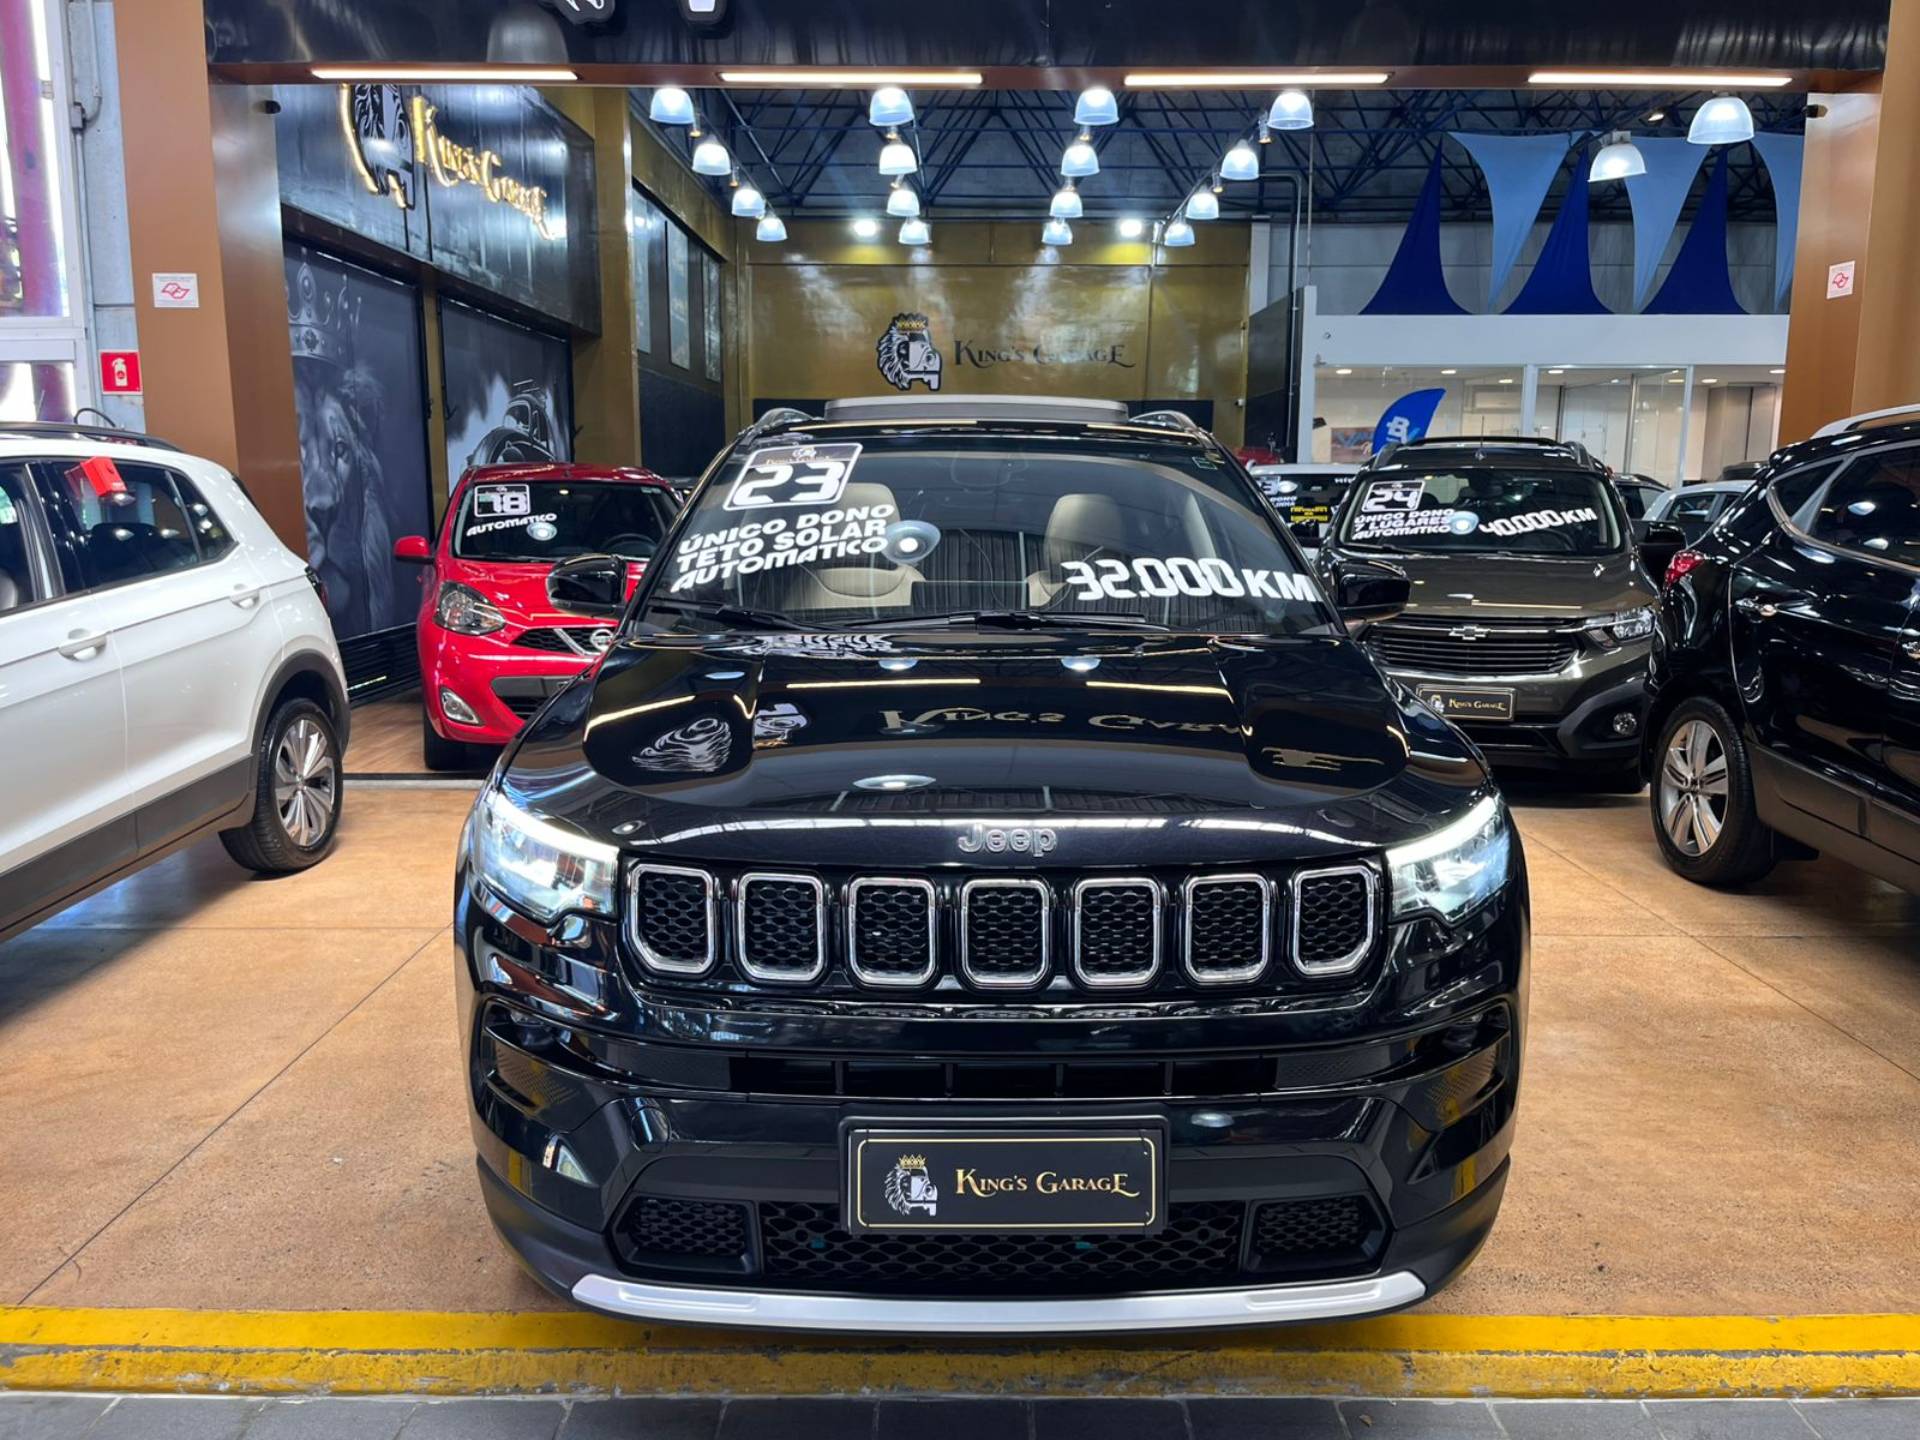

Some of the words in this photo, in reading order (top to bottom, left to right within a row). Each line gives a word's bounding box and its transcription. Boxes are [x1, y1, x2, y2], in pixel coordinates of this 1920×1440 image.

[953, 339, 1024, 369] KING'S
[733, 461, 845, 505] 23
[1366, 489, 1418, 510] 24
[1409, 508, 1456, 519] DONO
[466, 513, 558, 537] AUTOMATICO
[680, 518, 787, 554] ÚNICO
[796, 504, 895, 530] DONO
[1368, 515, 1450, 530] LUGARES
[1560, 507, 1598, 524] KM
[676, 538, 764, 573] TETO
[773, 519, 887, 551] SOLAR
[670, 536, 889, 593] AUTOMATICO
[1060, 557, 1246, 600] 32.000
[1241, 568, 1322, 602] KM
[957, 823, 1057, 857] Jeep
[955, 1168, 1028, 1198] KING'S
[1036, 1171, 1141, 1198] GARAGE
